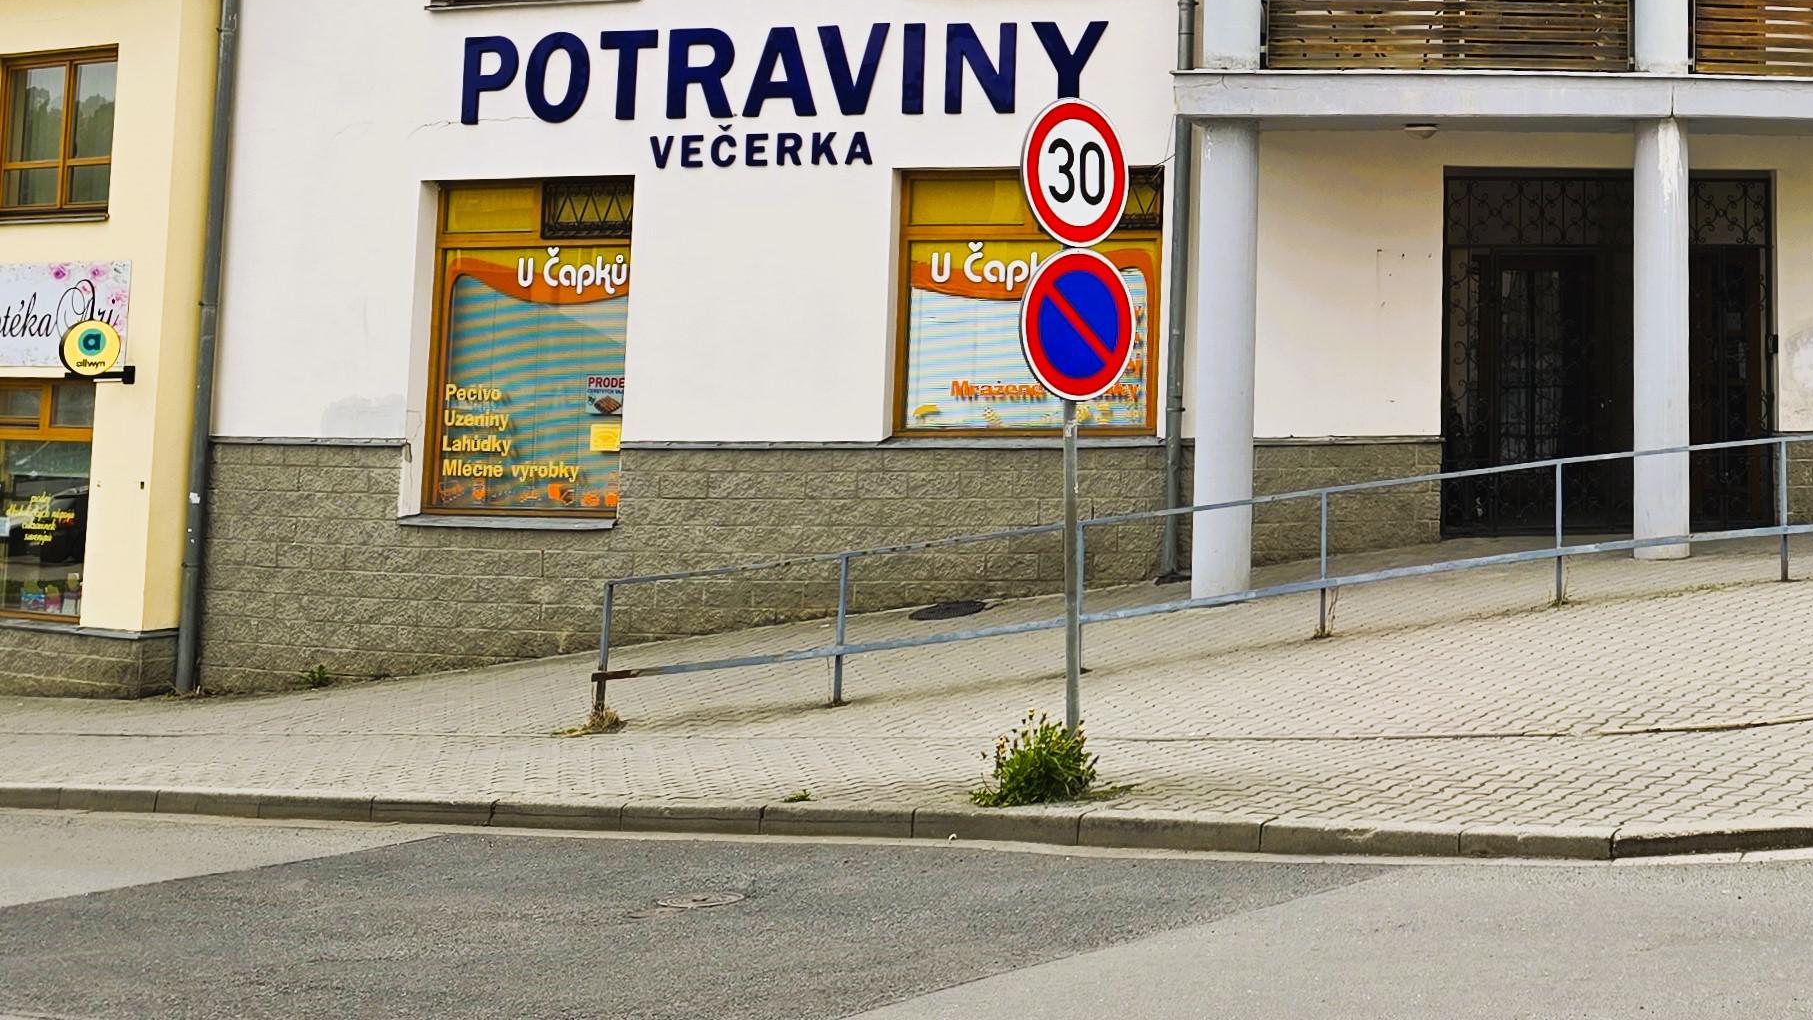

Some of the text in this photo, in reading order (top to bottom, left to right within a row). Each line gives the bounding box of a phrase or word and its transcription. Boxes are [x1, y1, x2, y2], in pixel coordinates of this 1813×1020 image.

[461, 21, 1109, 125] POTRAVINY
[650, 124, 873, 169] VEČERKA
[1048, 137, 1105, 206] 30
[517, 246, 628, 295] U Čapků
[931, 251, 951, 283] U
[0, 291, 55, 338] téka
[76, 358, 106, 370] allwyn
[444, 383, 502, 401] Pečivo
[442, 458, 580, 483] Mléčné výrobky
